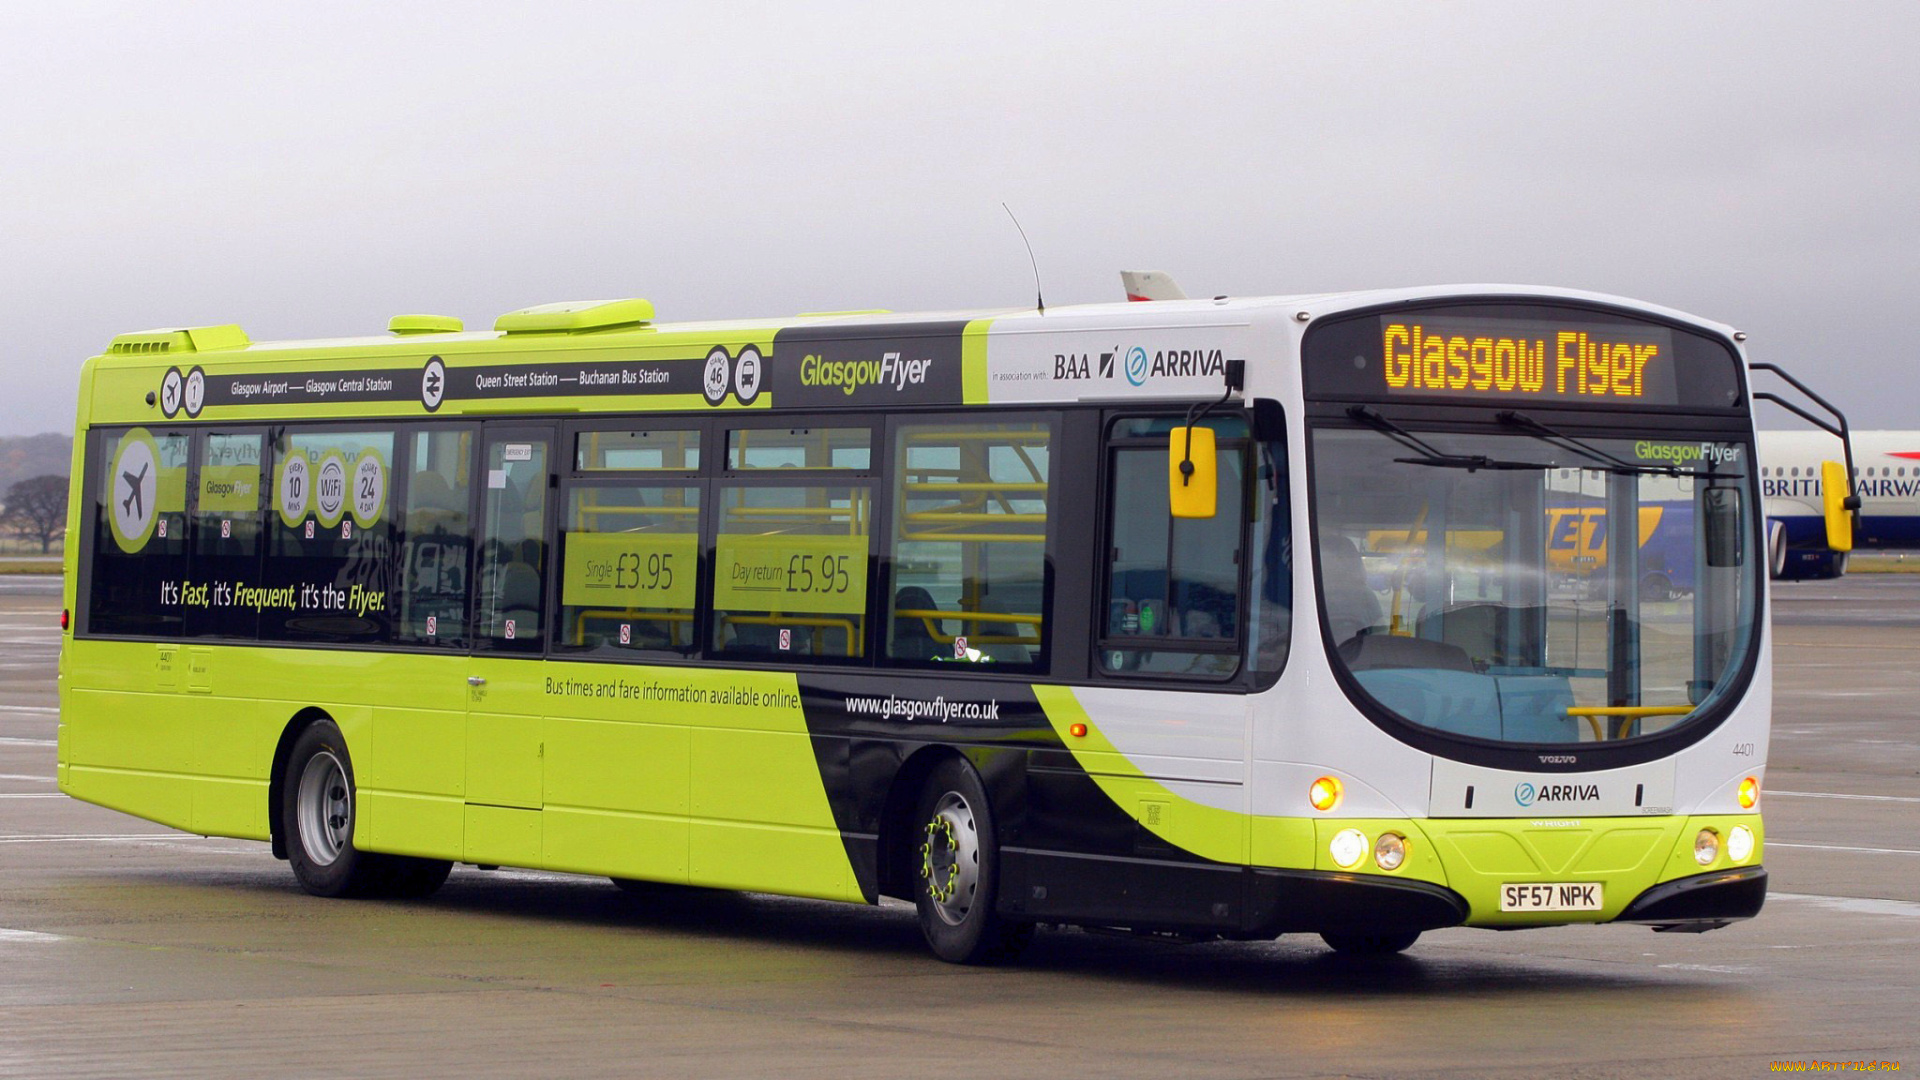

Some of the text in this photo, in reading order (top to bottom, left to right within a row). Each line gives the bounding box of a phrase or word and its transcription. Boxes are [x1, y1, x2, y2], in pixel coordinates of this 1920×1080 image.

[1053, 354, 1091, 380] BAA
[1150, 350, 1226, 377] ARRIVA
[1384, 324, 1659, 396] Glasgow Flyer
[476, 369, 669, 390] Queen Street Station Buchanan Bus Station
[710, 367, 722, 384] 46
[800, 352, 931, 395] GlasgowFlyer
[993, 370, 1048, 380] in association with:
[231, 376, 392, 398] Glasgow Airport Glasgow Central Station
[1635, 440, 1740, 466] GlasgowFlyer
[289, 463, 304, 474] EVERY
[360, 463, 378, 476] HOURS
[289, 477, 301, 498] 10
[321, 479, 341, 497] WiFi
[360, 477, 375, 499] 24
[1763, 479, 1847, 497] BRITI
[364, 501, 375, 513] DAY
[1545, 513, 1607, 550] ET
[585, 553, 673, 590] Single £3.95
[732, 554, 849, 593] Day return £5.95
[161, 580, 386, 618] It's Fast, it's Frequent, it's the Flyer.
[545, 677, 801, 709] Bus times and fare information available online.
[845, 694, 999, 723] www.glasgowflyer.co.uk
[1538, 755, 1577, 764] VOLVO
[1732, 743, 1755, 757] 4401
[1537, 784, 1600, 802] ARRIVA
[1506, 885, 1596, 907] SF57 NPK
